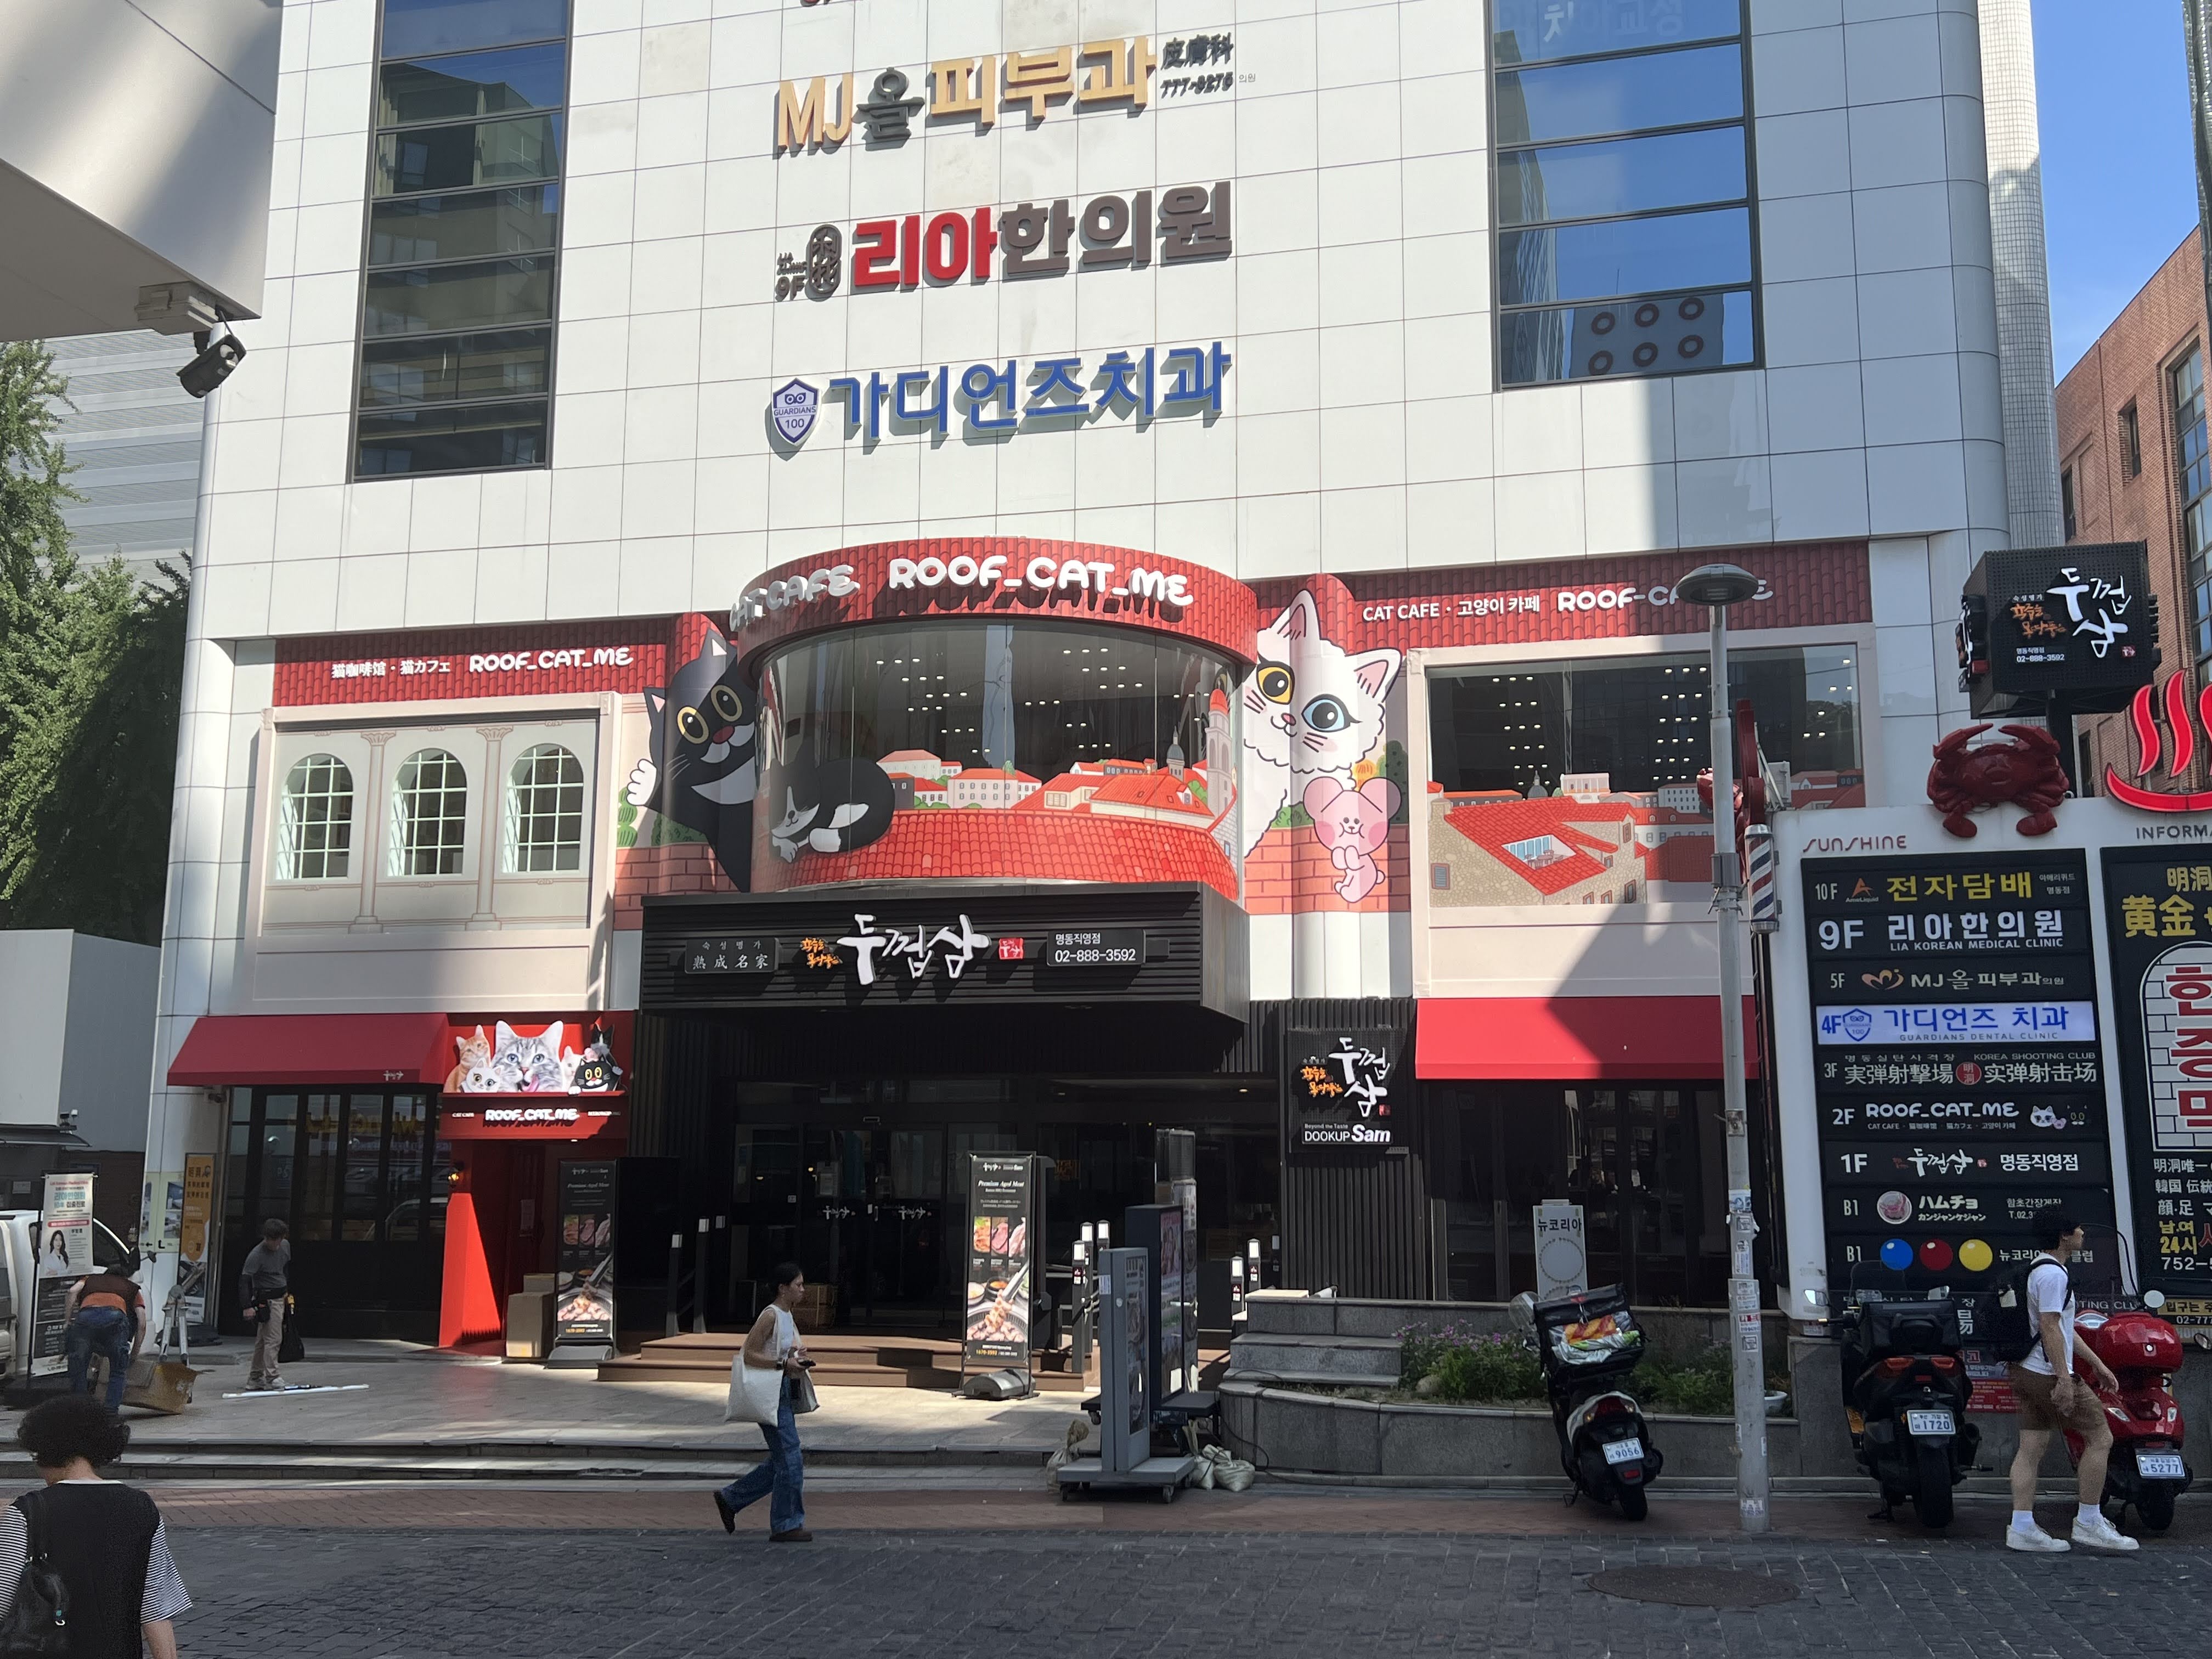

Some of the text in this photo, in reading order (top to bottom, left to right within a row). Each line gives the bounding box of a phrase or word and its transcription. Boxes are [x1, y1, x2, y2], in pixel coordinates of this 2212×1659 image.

[1238, 73, 1256, 83] 의원
[853, 181, 1232, 287] 리아한의원
[828, 341, 1231, 438] 가디언즈치과
[774, 405, 816, 417] GUARDIANS
[785, 417, 805, 430] 100
[767, 565, 860, 610] CAFE
[1363, 594, 1540, 621] CAT CAFE 고양이 카페
[400, 659, 450, 674] 猫カフェ
[469, 647, 634, 673] ROOF_CAT_ME
[2136, 825, 2212, 839] INFORM
[1803, 835, 1907, 853] SUNSHINE
[1887, 871, 2032, 901] 전자담배
[1819, 910, 2063, 950] 9F 리아한의원
[1056, 933, 1101, 945] 명동직영점
[1891, 938, 2063, 951] LIA KOREAN MEDICAL CLINIC
[837, 913, 990, 985] 두껍삼
[1055, 949, 1136, 963] 02-888-3592
[692, 953, 769, 970] 熟成名家
[1831, 973, 1845, 989] 5F
[1822, 1006, 2069, 1034] 4F 가디언즈 치과
[1824, 1063, 1837, 1078] 3F
[1984, 1062, 2097, 1084] 实弹射击场
[1832, 1108, 1855, 1125] 2F
[1841, 1154, 1867, 1173] 1F
[1907, 1148, 1973, 1177] 두껍삼
[2000, 1154, 2079, 1171] 명동직영점
[2155, 1179, 2182, 1193] 韓国
[1843, 1195, 1978, 1216] B1 ハムチョ
[1538, 1218, 1582, 1232] 뉴코리아
[1918, 1213, 1986, 1222] カンジャンケジャン
[2160, 1236, 2197, 1255] 24시
[1847, 1246, 1861, 1262] B1
[2161, 1257, 2212, 1270] 752-
[2166, 1302, 2199, 1312] 입구는
[1923, 1420, 1950, 1430] 1720
[1616, 1447, 1639, 1458] 9056
[2151, 1464, 2178, 1473] 5277
